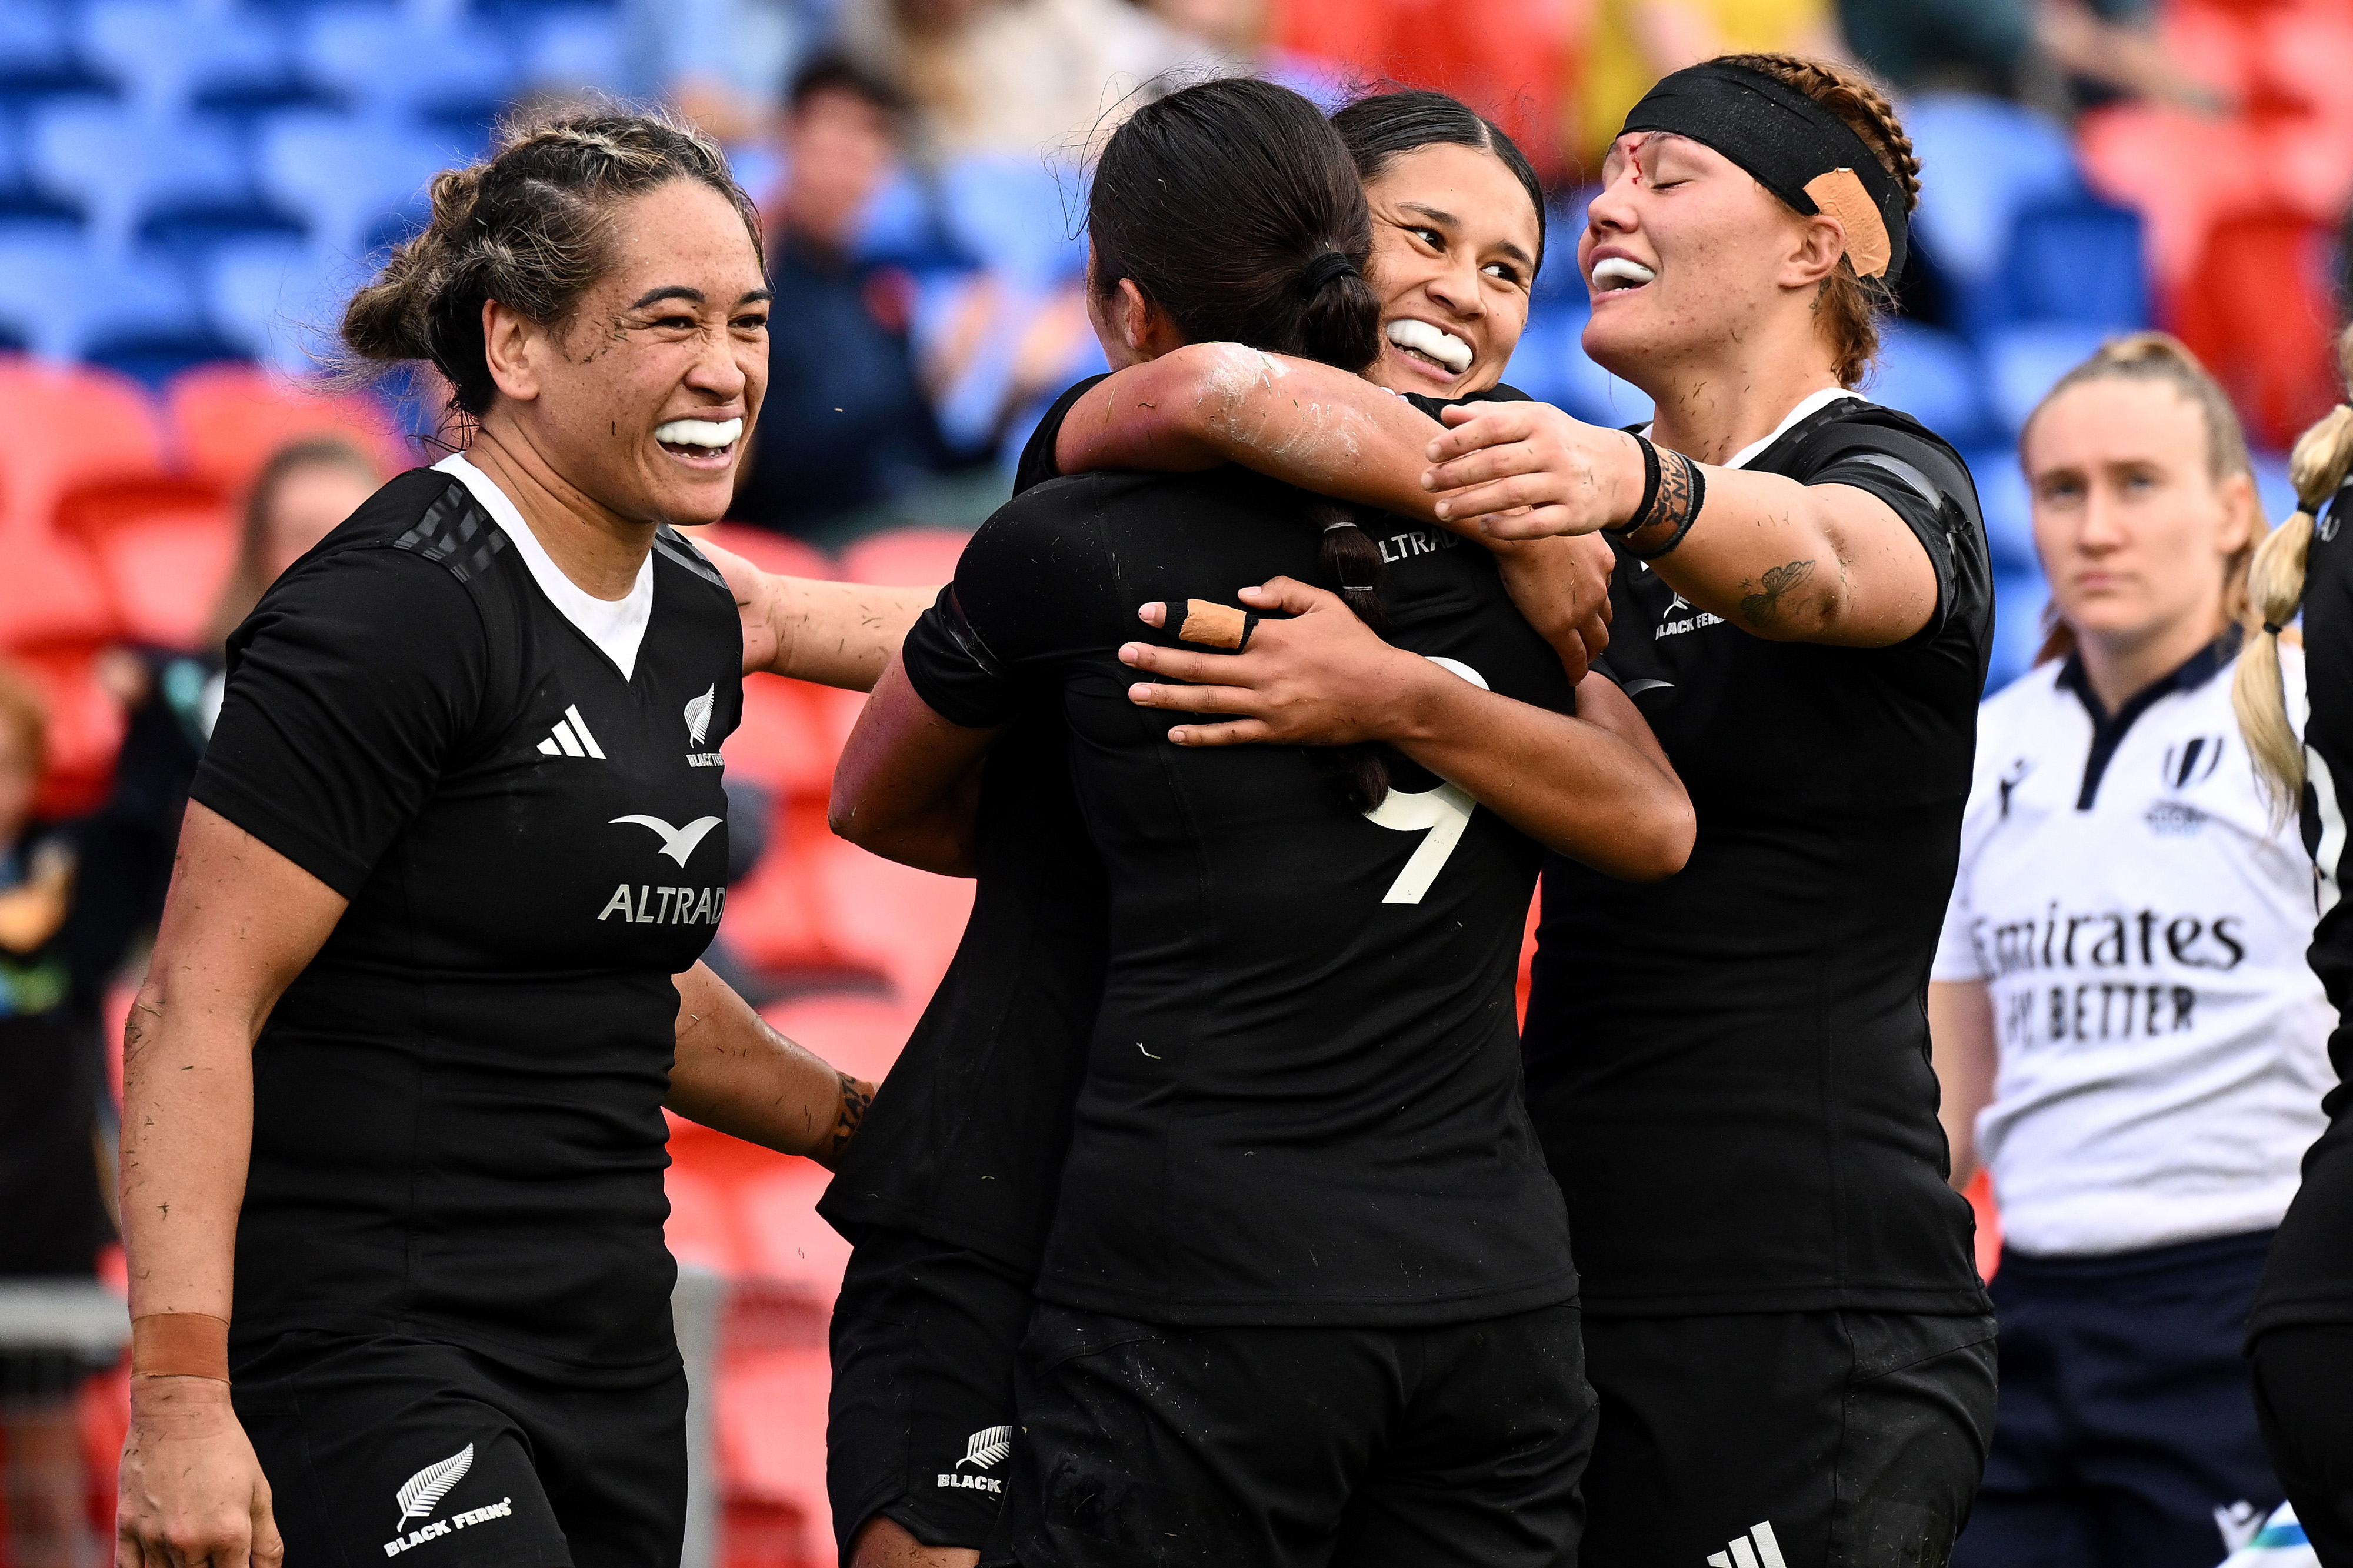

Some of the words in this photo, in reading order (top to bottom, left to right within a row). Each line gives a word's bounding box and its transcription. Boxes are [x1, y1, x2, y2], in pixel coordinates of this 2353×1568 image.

[1378, 528, 1460, 563] LTRAD
[596, 883, 726, 925] ALTRAD
[2049, 982, 2197, 1040] BETTER
[937, 1474, 1001, 1493] BLACK
[383, 1519, 452, 1558] BLACK
